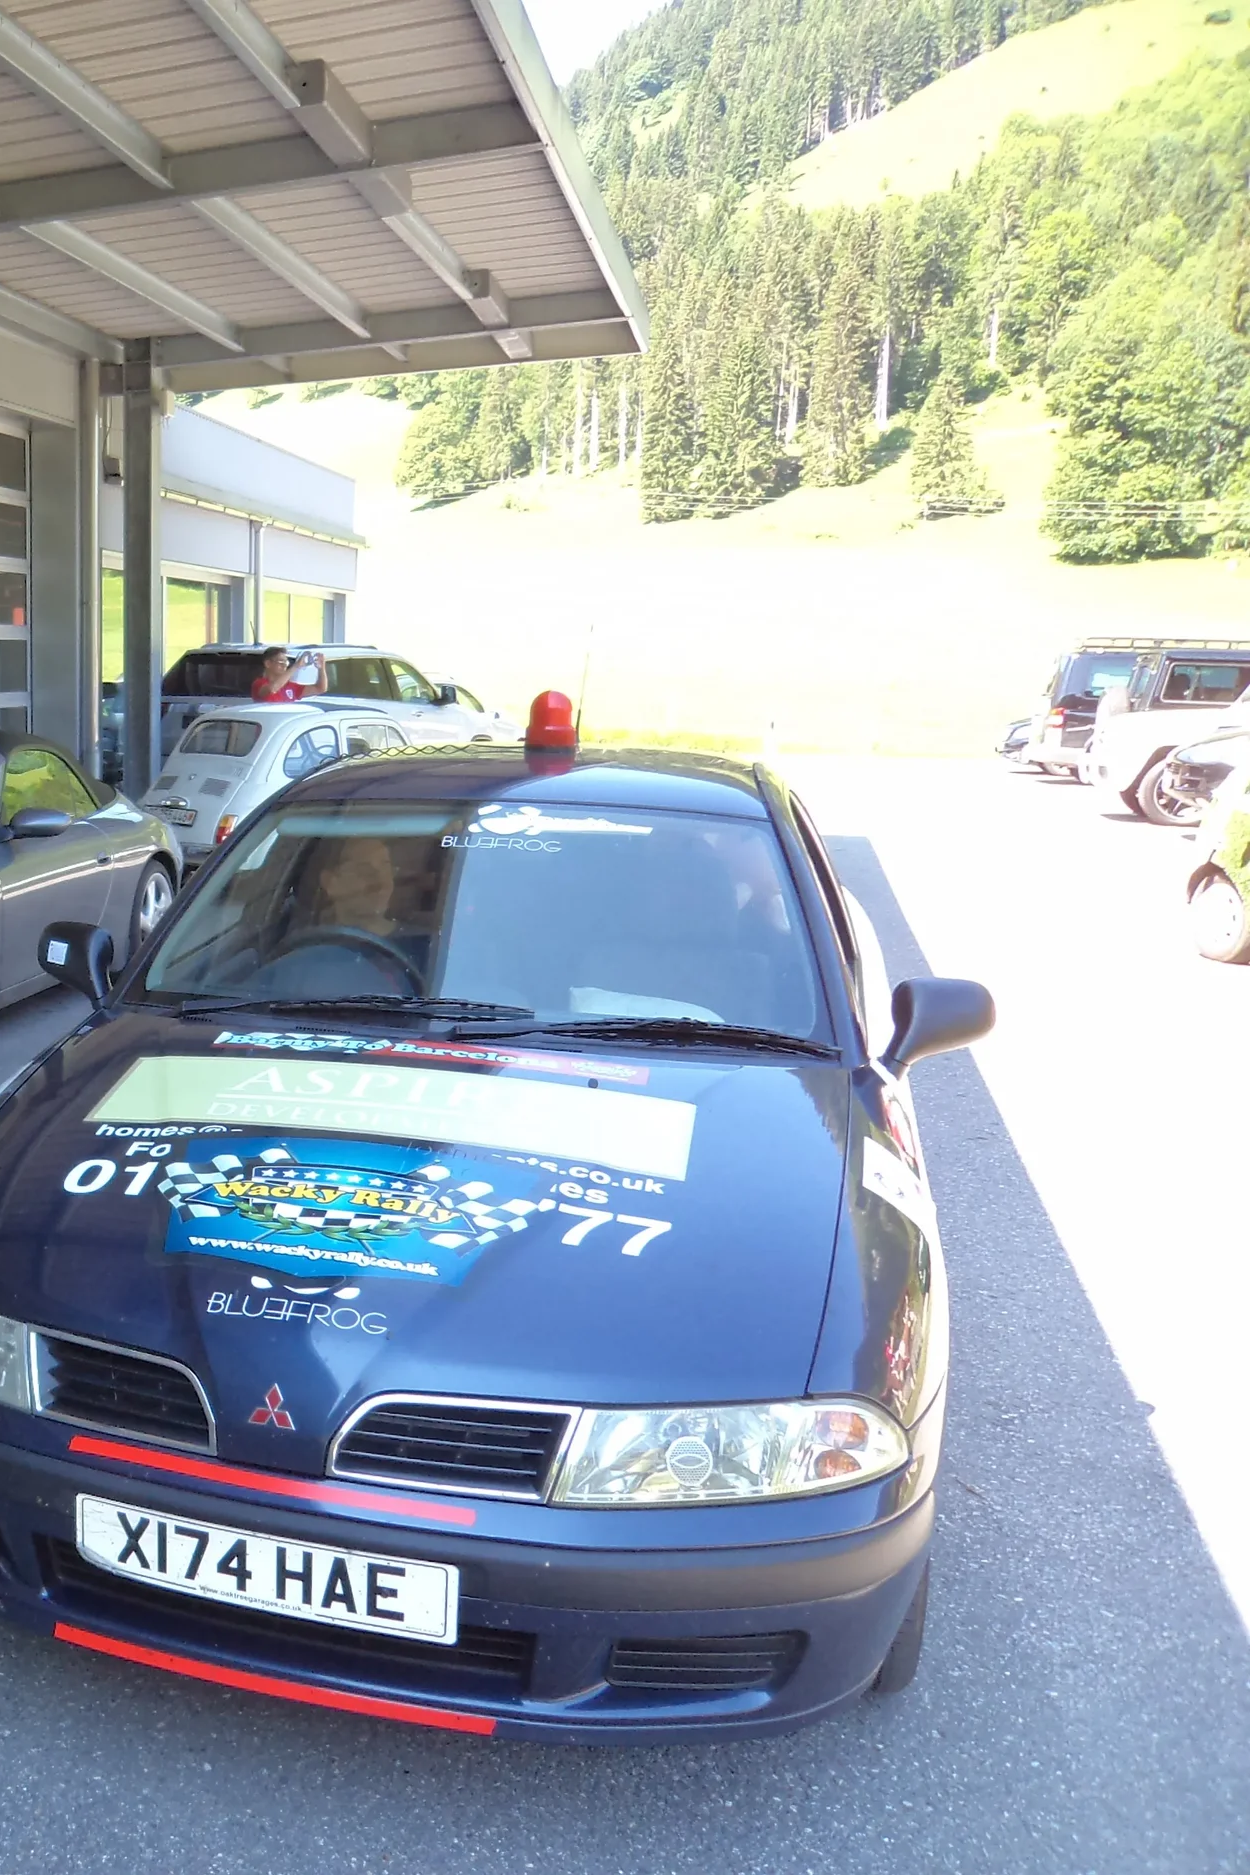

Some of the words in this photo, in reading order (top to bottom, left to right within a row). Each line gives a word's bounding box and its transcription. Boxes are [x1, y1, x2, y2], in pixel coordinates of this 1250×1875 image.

[390, 1042, 560, 1069] Barcelona
[212, 1180, 346, 1205] Wacky
[351, 1189, 461, 1224] Rally
[188, 1235, 440, 1276] www.wackyrally.co.uk
[116, 1511, 253, 1592] X174
[275, 1546, 406, 1622] HAE
